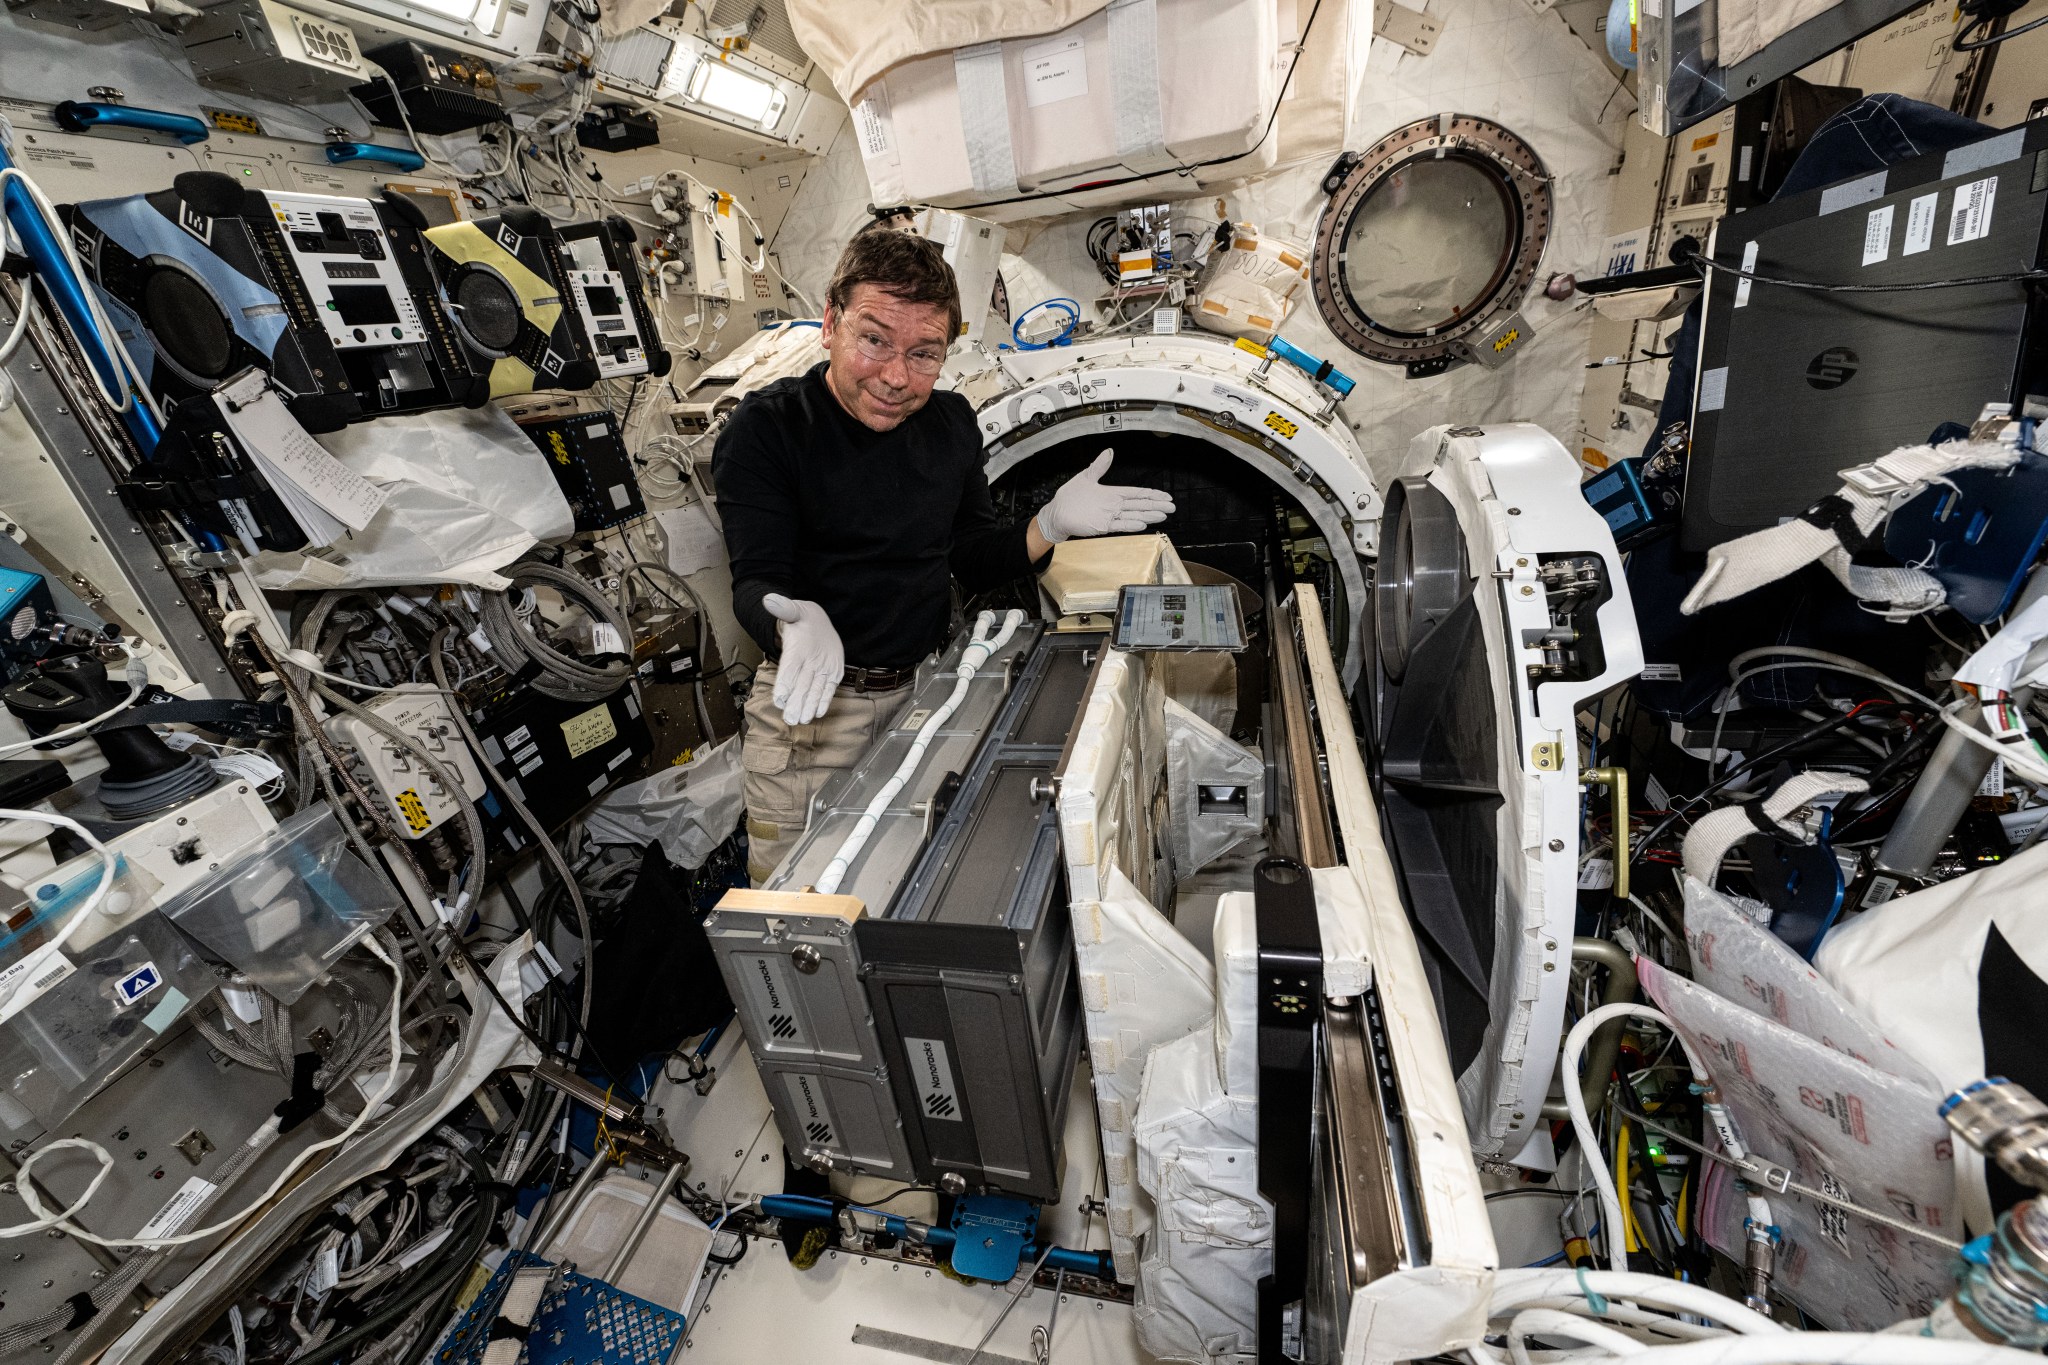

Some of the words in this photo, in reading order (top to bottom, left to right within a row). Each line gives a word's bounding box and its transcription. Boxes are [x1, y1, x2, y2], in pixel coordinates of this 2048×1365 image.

[1900, 18, 1927, 35] BOTTLE
[1931, 12, 1946, 24] GAS
[1883, 30, 1898, 42] UNIT
[1602, 252, 1636, 277] JAXA
[1742, 264, 1752, 285] EA
[1806, 354, 1858, 382] hp
[394, 711, 410, 721] POWER
[400, 712, 422, 726] EFFECTOR
[7, 963, 24, 976] Bag
[136, 980, 143, 988] 1
[758, 959, 782, 1009] Nanoracks
[923, 1041, 941, 1089] Nanoracks
[798, 1076, 819, 1118] Nanoracks
[1718, 1126, 1734, 1146] M/W
